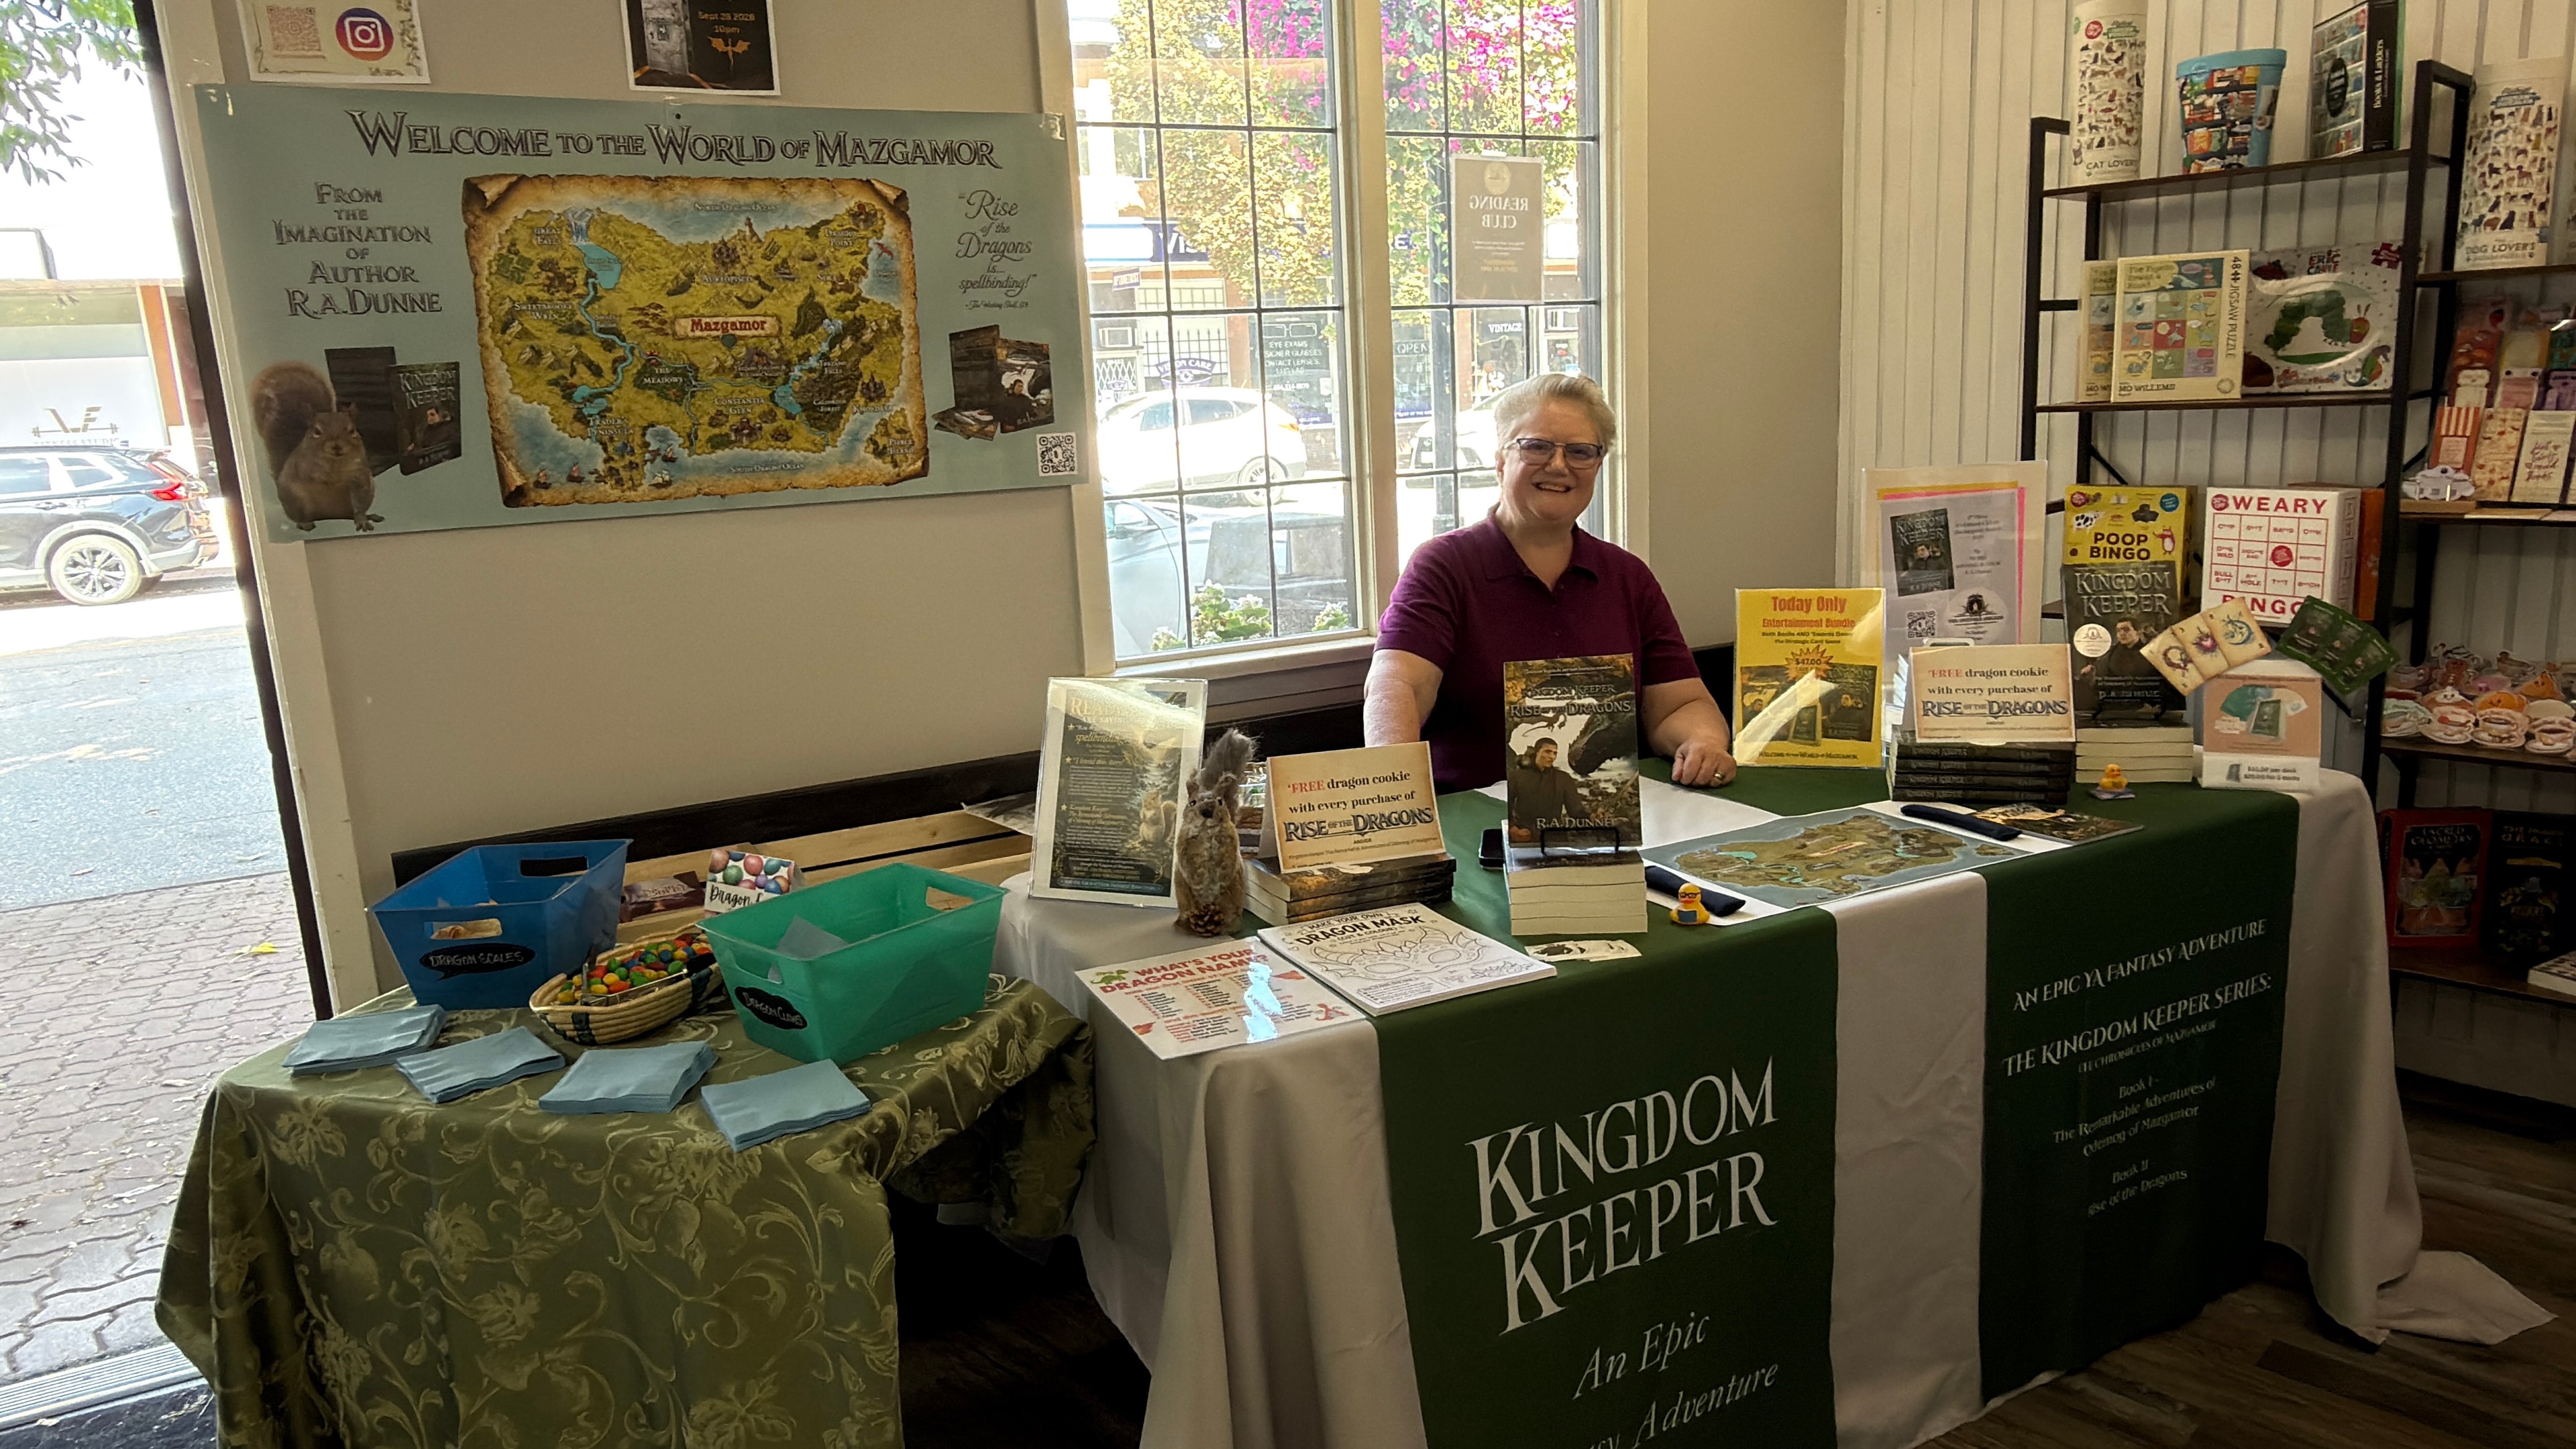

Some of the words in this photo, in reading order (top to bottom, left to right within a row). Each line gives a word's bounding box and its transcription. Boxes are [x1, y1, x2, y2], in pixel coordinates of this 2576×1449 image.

[344, 109, 553, 158] WELCOME
[556, 132, 592, 154] TO
[597, 133, 646, 156] THE
[645, 123, 775, 165] WORLD
[780, 140, 810, 159] OF
[813, 130, 1003, 169] MAZGAMOR
[315, 182, 383, 205] FROM
[333, 207, 369, 221] THE
[272, 219, 433, 245] IMAGINATION
[345, 246, 370, 260] OF
[955, 231, 1032, 262] Dragons
[307, 260, 419, 283] AUTHOR
[690, 318, 767, 334] Mazgamor
[1488, 322, 1523, 333] VINTAGE
[1158, 360, 1187, 373] VISON
[2233, 494, 2328, 515] WEARY
[2094, 532, 2149, 545] POOP
[2090, 545, 2151, 560] BINGO
[2074, 572, 2171, 594] KINGDOM
[1772, 595, 1812, 613] Today
[1817, 596, 1847, 614] Only
[2081, 594, 2172, 617] KEEPER
[2222, 594, 2305, 616] NGO
[1762, 618, 1823, 628] Entertainment
[1965, 669, 2007, 680] dragon
[2009, 667, 2049, 678] cookie
[1575, 684, 1617, 695] KEEPER
[1927, 686, 1953, 694] with
[1955, 687, 1984, 696] every
[1988, 685, 2039, 696] purchase
[2041, 684, 2053, 693] of
[1511, 704, 1541, 718] RISE
[1567, 700, 1631, 715] DRAGONS
[1921, 700, 1962, 718] RISE
[1986, 699, 2069, 717] DRAGONS
[1327, 777, 1370, 790] dragon
[1372, 770, 1411, 785] cookie
[1289, 802, 1316, 814] with
[1317, 800, 1348, 811] every
[1351, 793, 1402, 808] purchase
[1403, 790, 1416, 800] of
[1283, 819, 1330, 842] RISE
[1338, 820, 1353, 828] THE
[1351, 807, 1434, 833] DRAGONS
[709, 885, 751, 907] Dragon
[1294, 922, 1370, 946] DRAGON
[1371, 915, 1426, 928] MASK
[1307, 921, 1334, 930] MAKE
[1335, 916, 1358, 924] YOUR
[1360, 912, 1384, 920] OWN
[429, 954, 478, 967] DRAGON
[1134, 959, 1203, 977] WHAT'S
[1203, 948, 1254, 963] YOUR
[2013, 987, 2038, 1012] AN
[2043, 975, 2081, 1002] EPIC
[2083, 968, 2106, 989] YA
[2107, 947, 2175, 982] FANTASY
[2178, 918, 2267, 960] ADVENTURE
[1099, 969, 1196, 994] DRAGON
[2002, 1049, 2036, 1077] THE
[2041, 1015, 2139, 1065] KINGDOM
[2143, 993, 2210, 1032] KEEPER
[2212, 971, 2273, 1009] SERIES:
[2118, 1079, 2145, 1099] Book
[2053, 1128, 2076, 1143] The
[2078, 1103, 2141, 1136] Remarkable
[2144, 1085, 2206, 1108] Adventures
[2127, 1122, 2139, 1136] of
[1464, 1055, 1780, 1240] KINGDOM
[2112, 1164, 2140, 1184] Book
[2140, 1169, 2188, 1193] Dragons
[1491, 1150, 1780, 1337] KEEPER
[1571, 1346, 1627, 1400] An
[1638, 1311, 1711, 1373] Epic
[1631, 1363, 1780, 1449] Adventure
